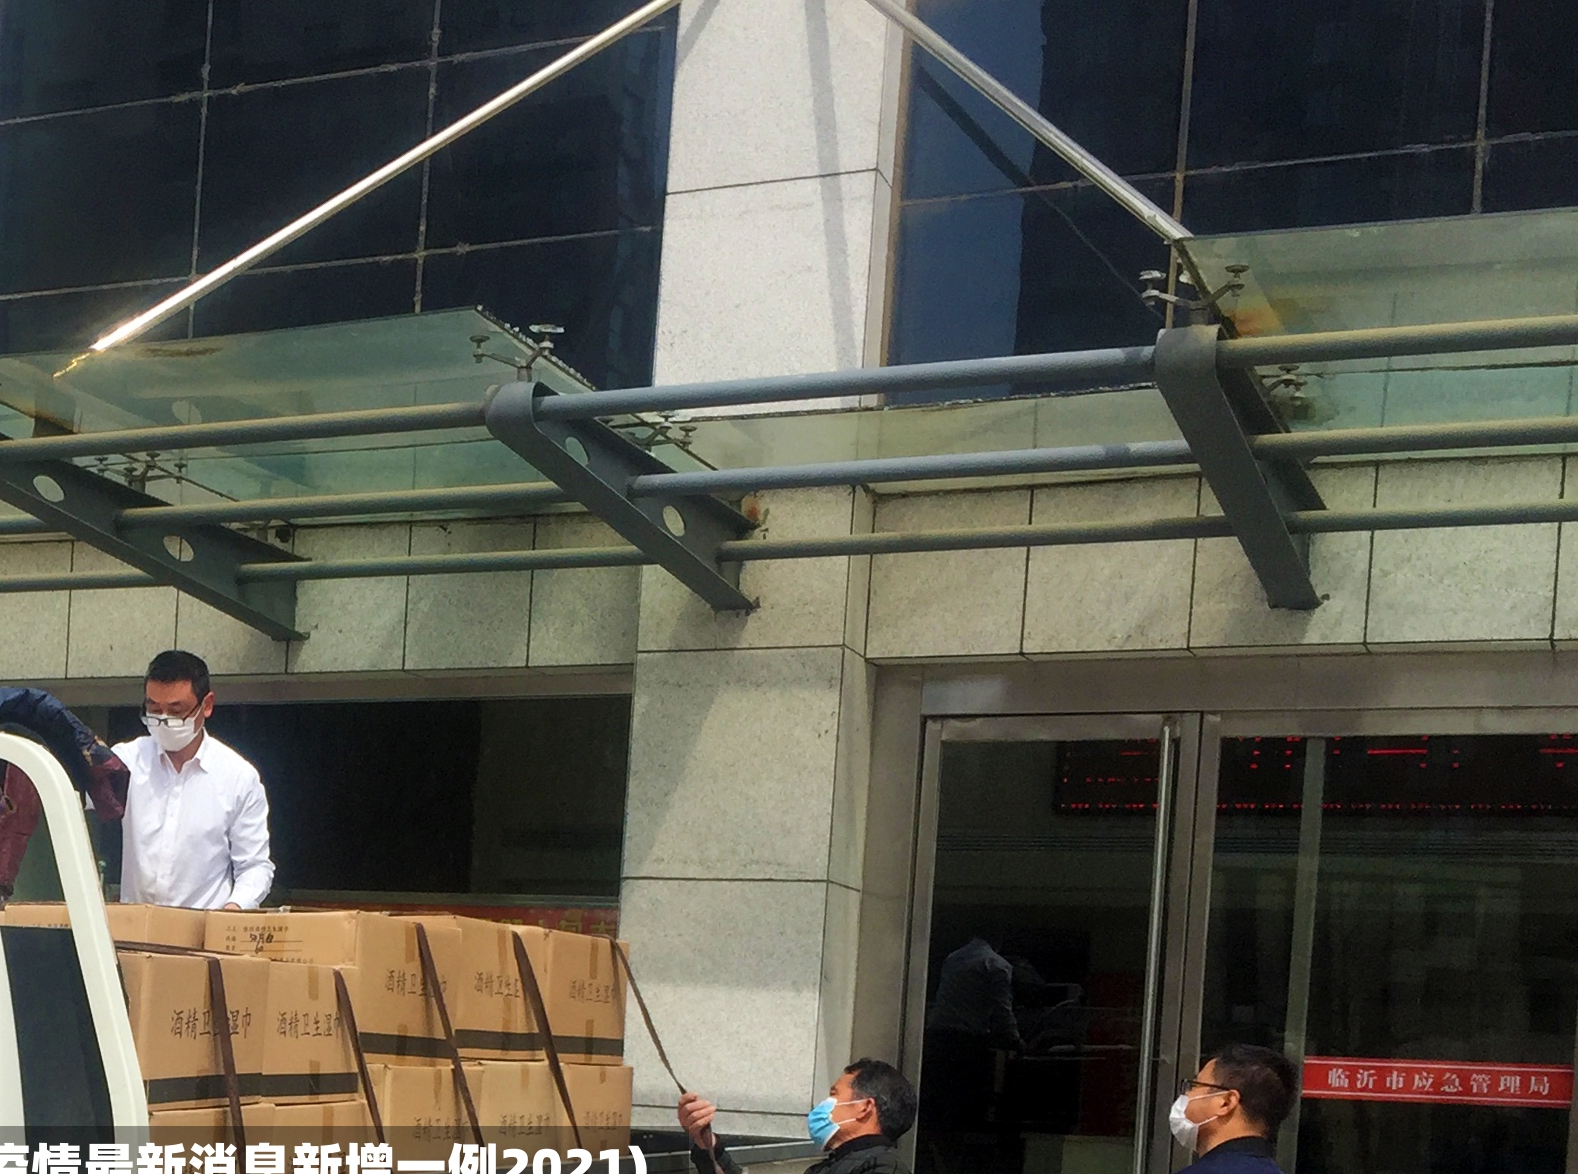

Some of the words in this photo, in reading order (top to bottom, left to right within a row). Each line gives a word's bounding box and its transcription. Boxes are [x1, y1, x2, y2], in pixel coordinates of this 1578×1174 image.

[385, 969, 447, 997] 酒精卫生巾
[171, 1007, 252, 1039] 酒精卫湿巾
[1327, 1067, 1550, 1096] 临沂市应急管理局
